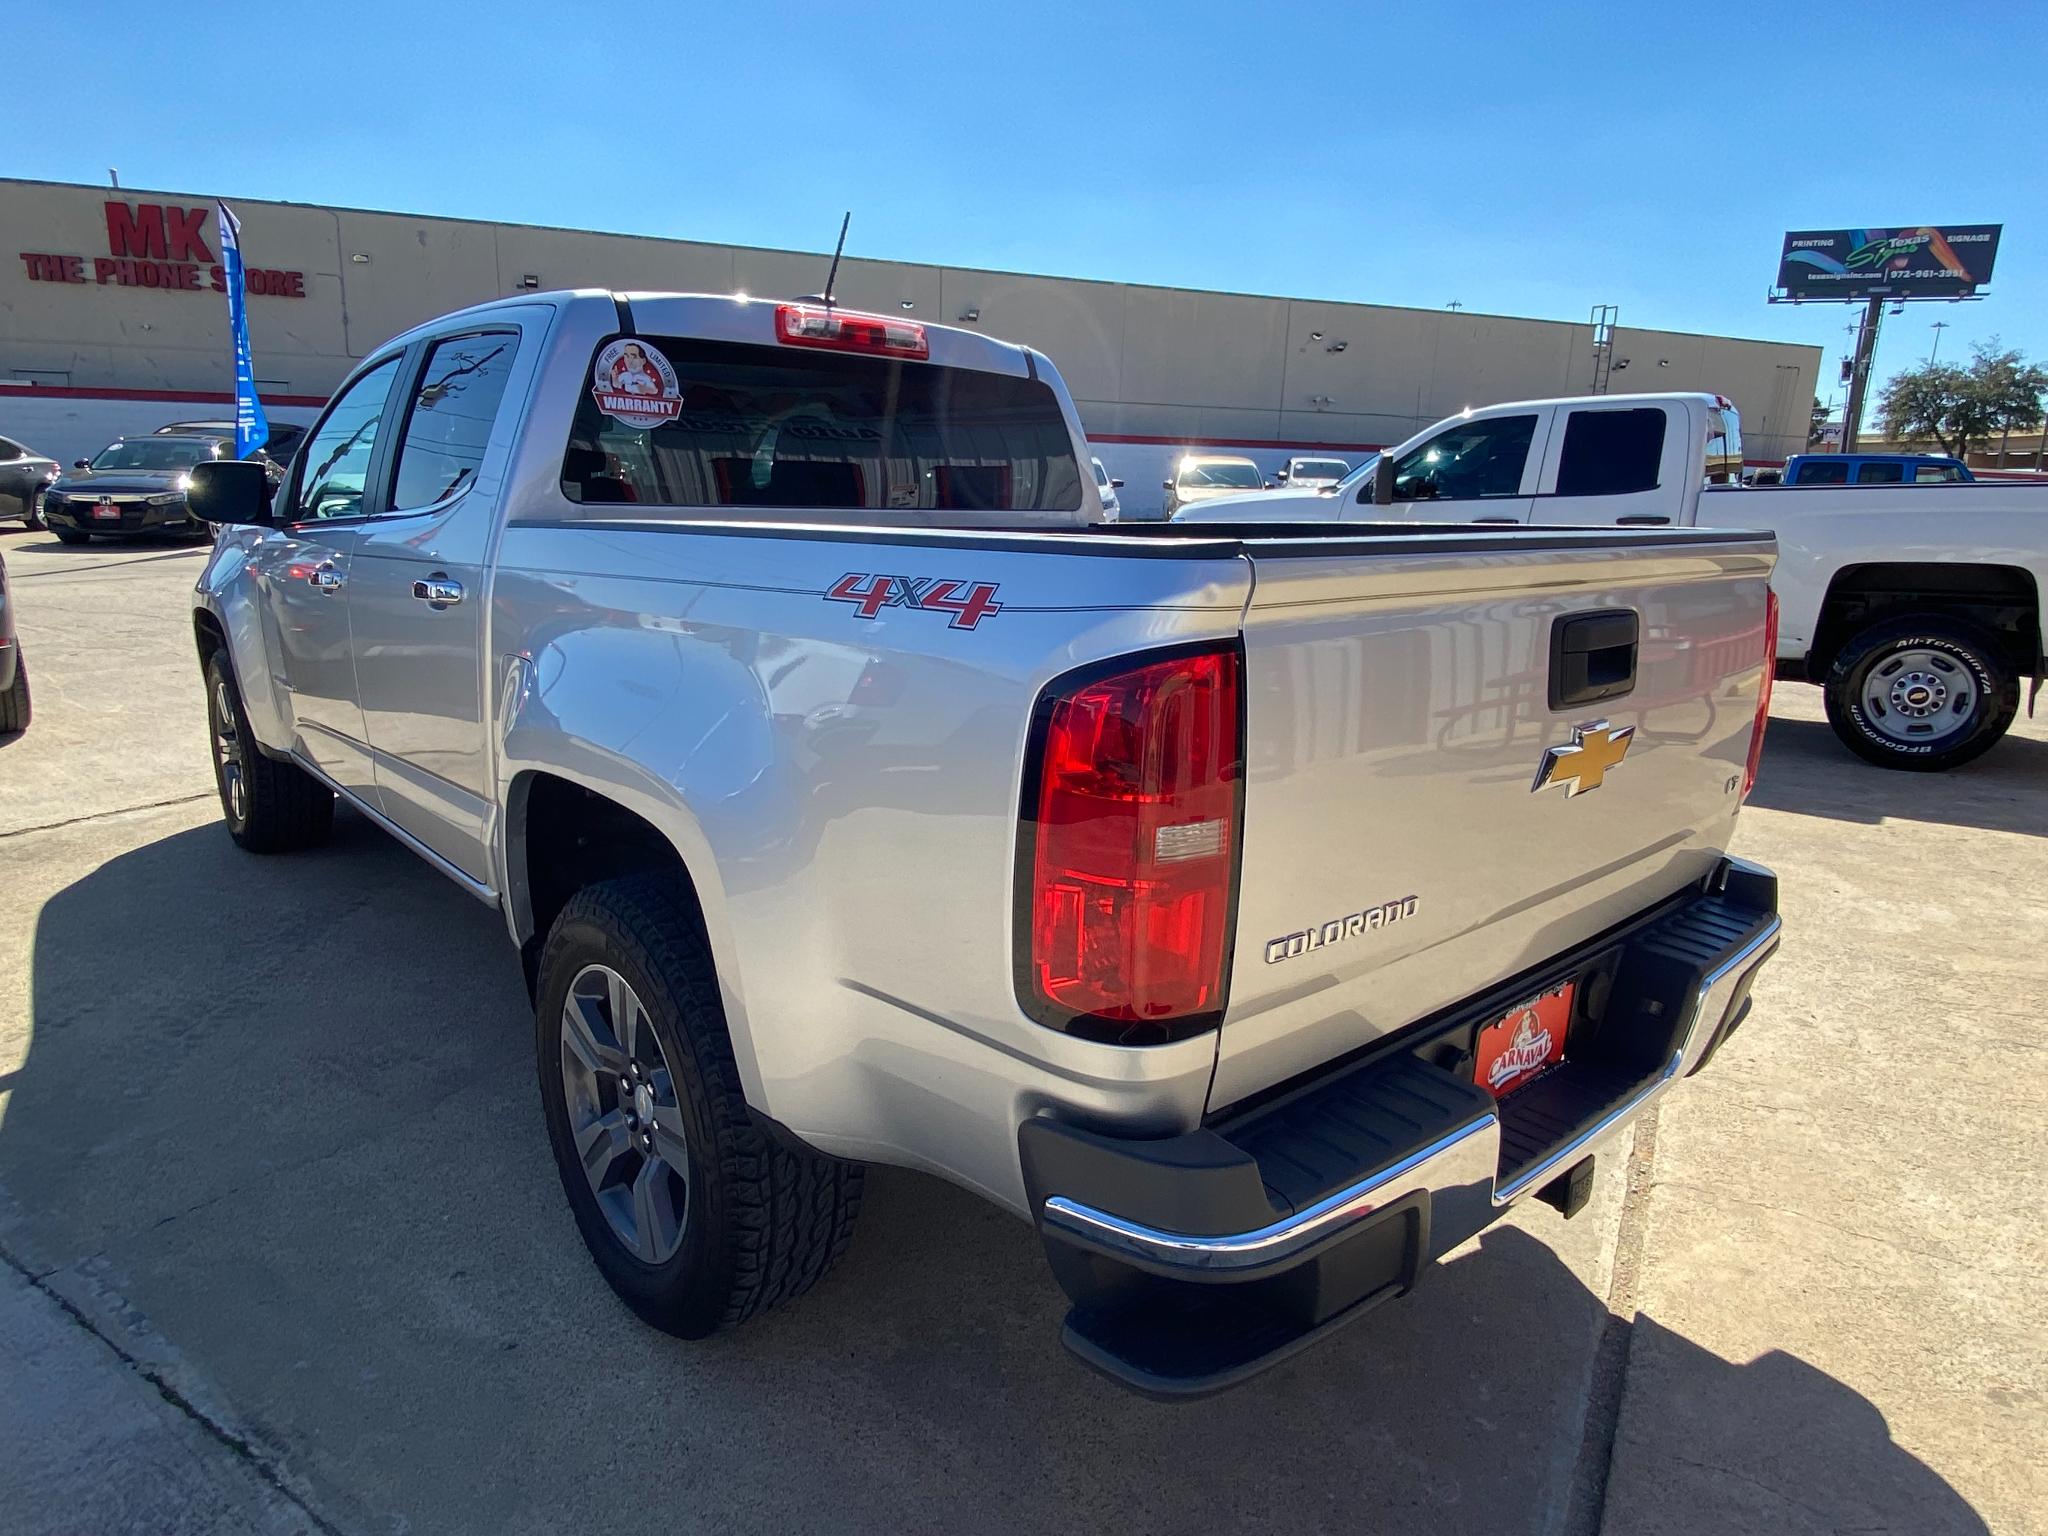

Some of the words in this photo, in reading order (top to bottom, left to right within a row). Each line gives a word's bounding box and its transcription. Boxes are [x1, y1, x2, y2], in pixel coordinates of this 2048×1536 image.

[105, 202, 215, 262] MK
[1792, 238, 1834, 247] PRINTING
[1889, 234, 1930, 248] Texas
[1946, 234, 1990, 243] SIGNAGE
[20, 253, 86, 284] THE
[94, 257, 202, 291] PHONE
[209, 265, 306, 298] SORE
[604, 347, 620, 363] FREE
[649, 351, 672, 378] LIMITED
[602, 396, 674, 415] WARRANTY
[1979, 671, 1992, 694] T/A
[1851, 704, 1932, 753] BFGoodrich
[1265, 894, 1420, 964] COLORADO
[1489, 1034, 1551, 1083] CARNAVAL
